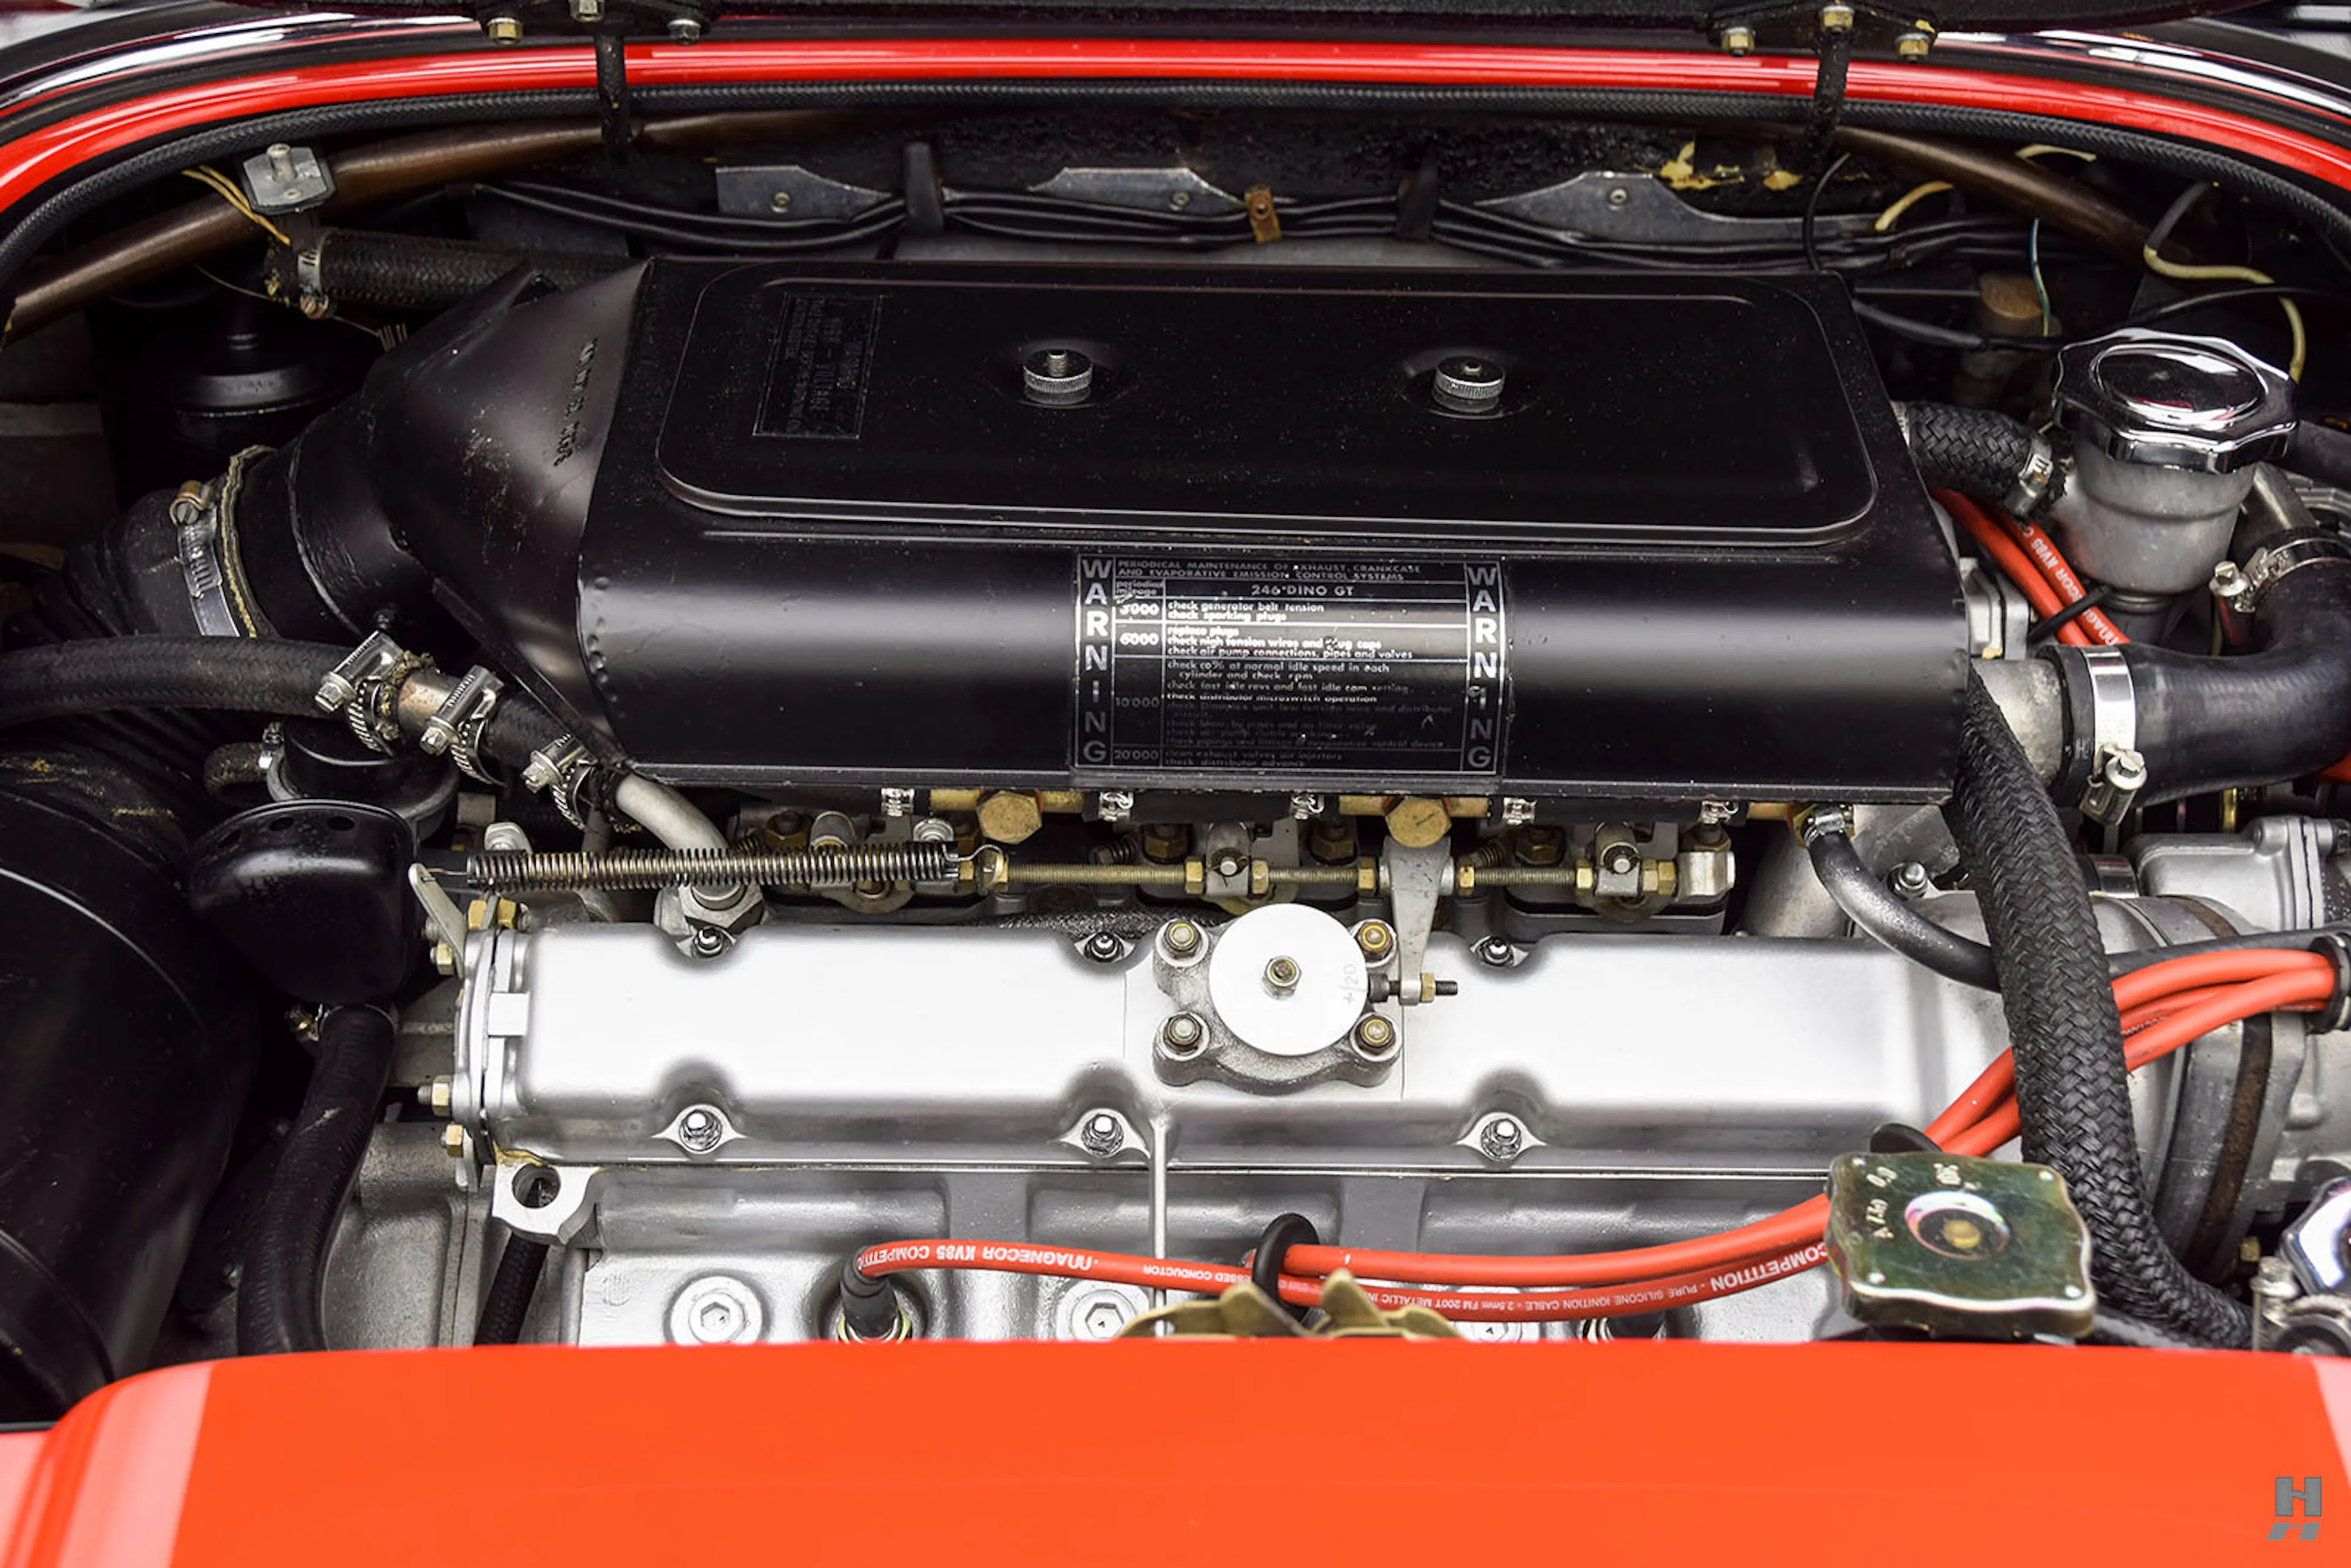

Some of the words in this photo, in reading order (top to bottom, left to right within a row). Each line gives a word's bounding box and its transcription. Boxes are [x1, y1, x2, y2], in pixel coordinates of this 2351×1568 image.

[1118, 560, 1181, 569] PERIODICAL
[1187, 561, 1267, 571] MAINTENANCE
[1352, 565, 1421, 574] CRANKCASE
[1149, 569, 1225, 577] EVAPORATIVE
[1287, 585, 1328, 596] DINO
[1333, 585, 1354, 597] GT
[1168, 601, 1198, 610] check
[1201, 602, 1254, 612] generator
[1258, 601, 1279, 612] belt
[1284, 602, 1325, 612] tension
[1168, 610, 1198, 620] check
[1256, 611, 1288, 623] plugs
[1168, 635, 1198, 645] check
[1226, 636, 1266, 647] tension
[1302, 637, 1324, 648] and
[1168, 646, 1198, 656] check
[1200, 647, 1216, 656] air
[1218, 648, 1250, 659] pump
[1323, 648, 1351, 659] pipes
[1354, 649, 1376, 658] and
[1378, 649, 1413, 659] valves
[1168, 659, 1198, 670] check
[1243, 661, 1284, 671] normal
[1288, 661, 1309, 671] idle
[1312, 661, 1345, 673] speed
[1348, 662, 1360, 672] in
[1363, 662, 1390, 673] each
[936, 1245, 978, 1261] KV85
[983, 1246, 1093, 1271] MAGNECOR
[1142, 1264, 1212, 1281] CONDUCTOR
[1615, 1288, 1665, 1307] SILICONE
[1667, 1283, 1698, 1299] PURE
[1381, 1293, 1433, 1308] METALLIC
[1525, 1300, 1560, 1312] CABLE
[1562, 1296, 1611, 1310] IGNITION
